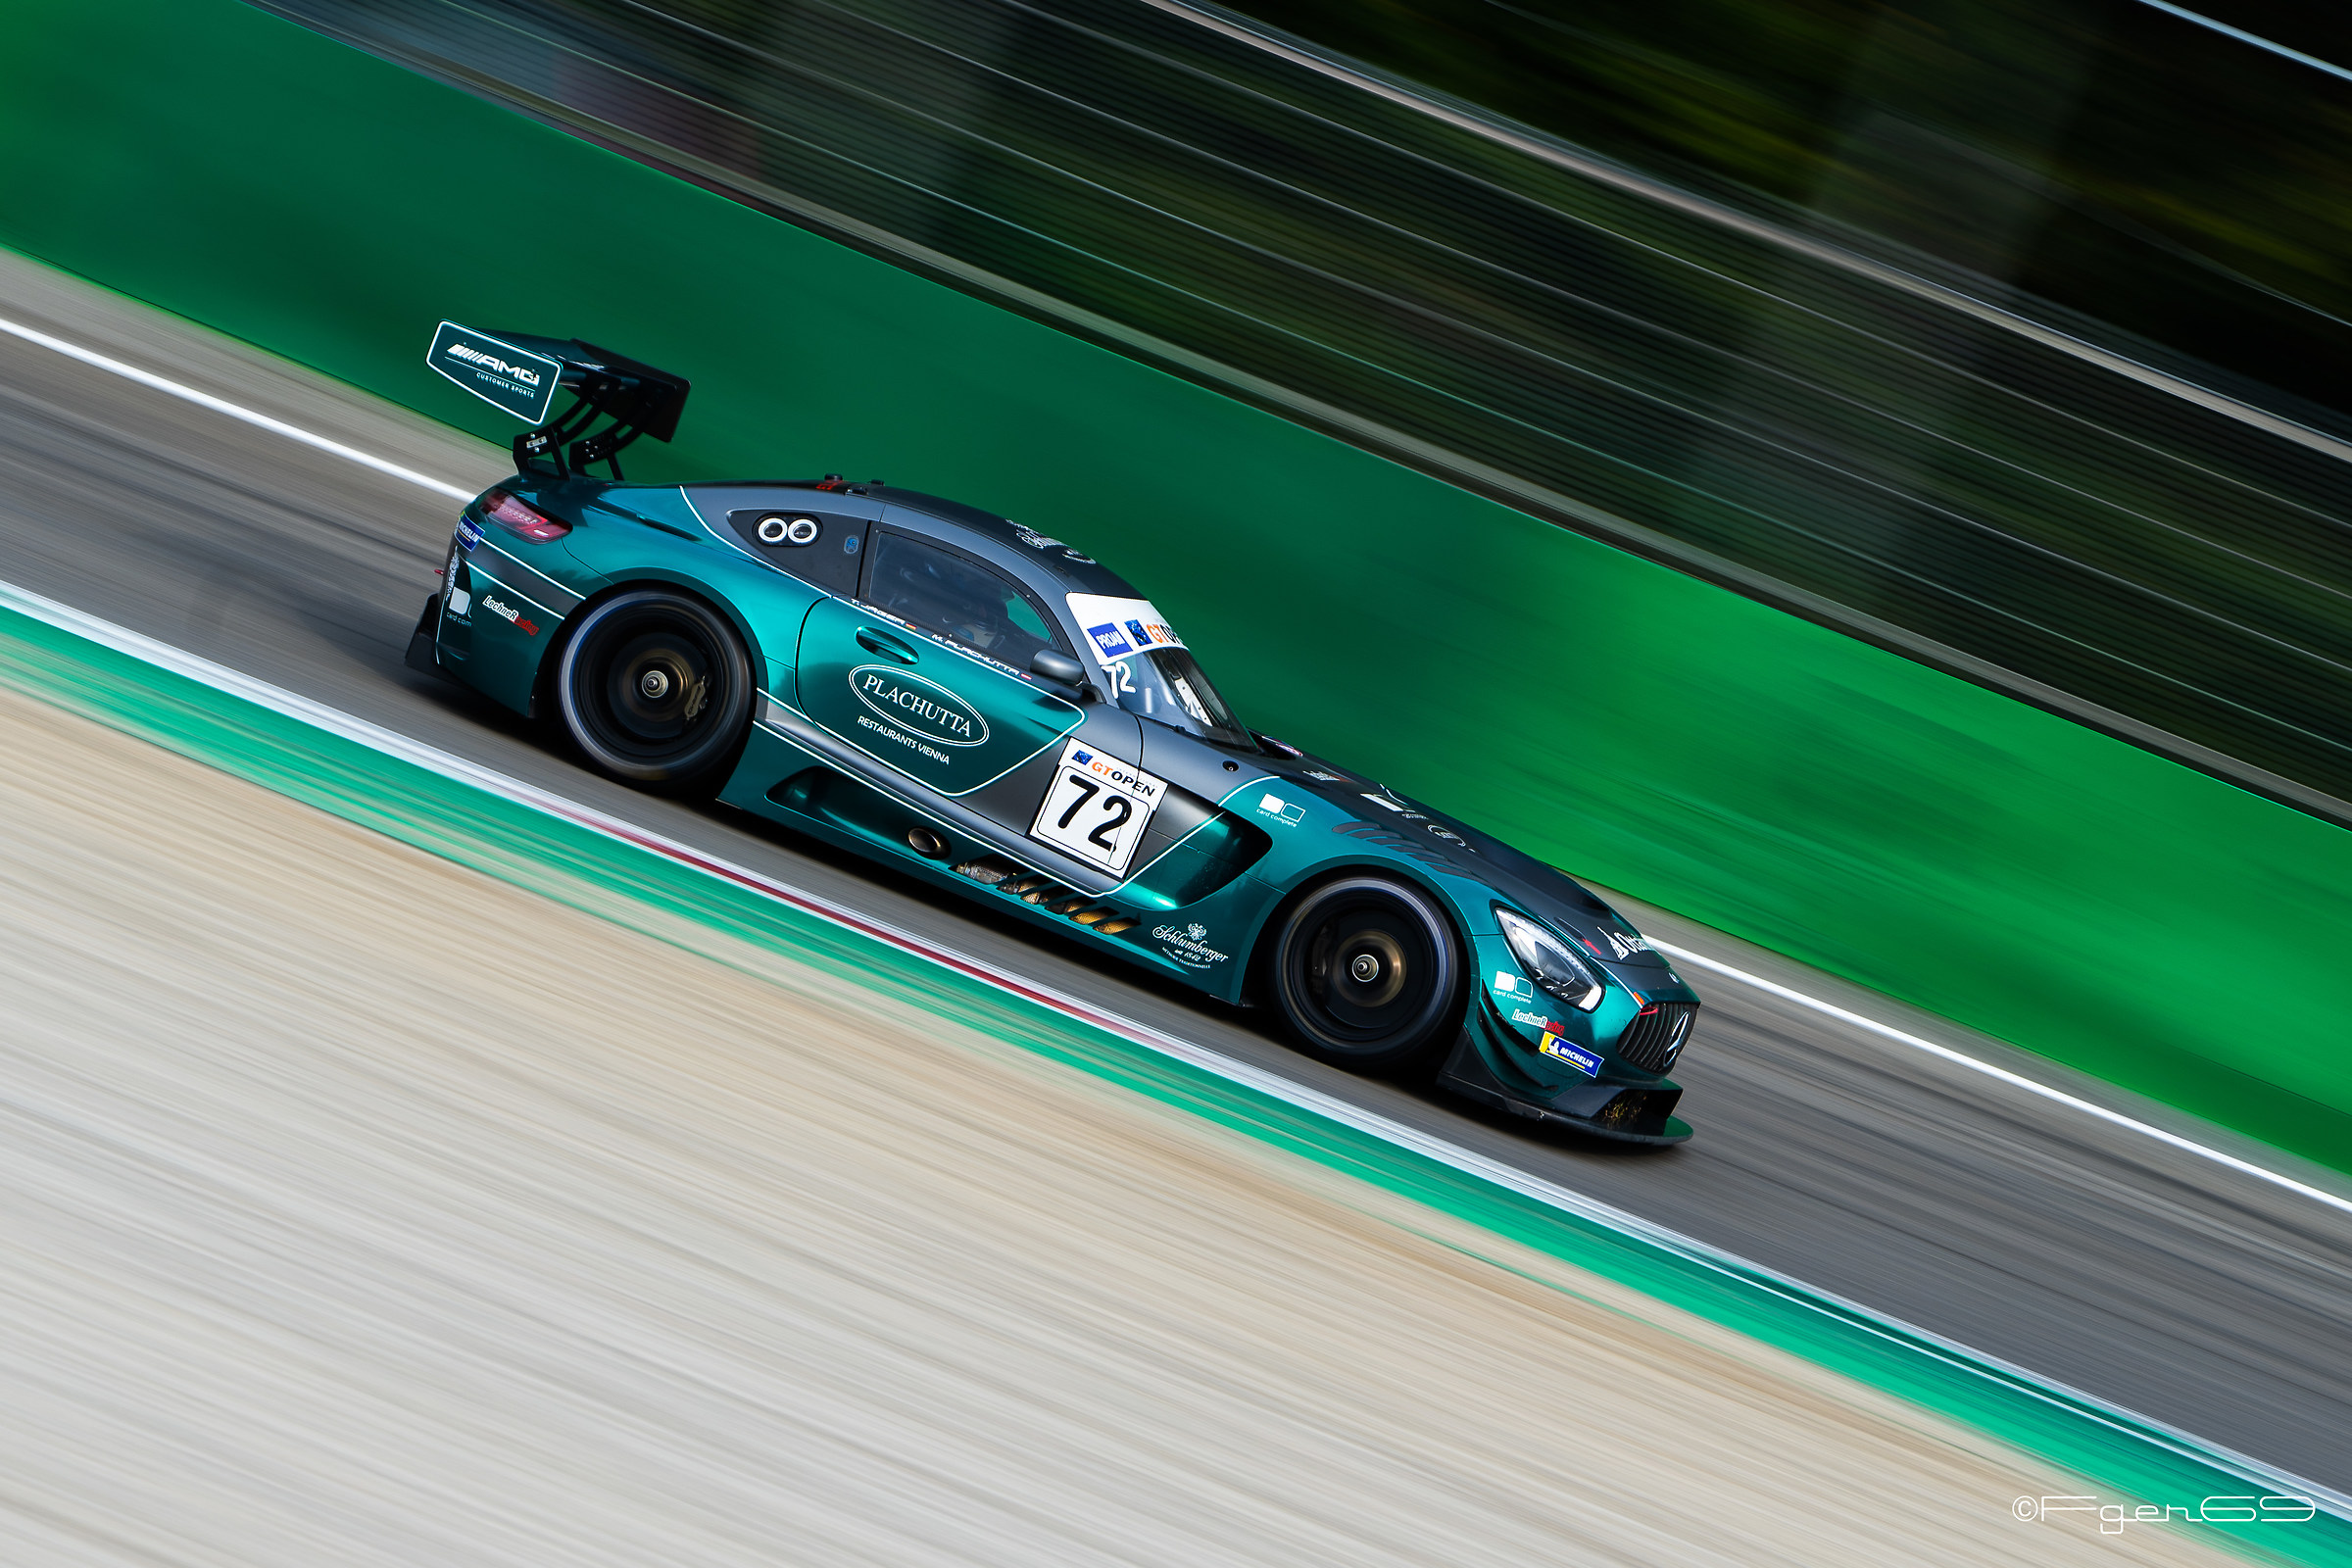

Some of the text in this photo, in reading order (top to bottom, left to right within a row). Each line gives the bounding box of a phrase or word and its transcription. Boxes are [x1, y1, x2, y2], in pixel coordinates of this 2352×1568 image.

[476, 371, 535, 399] CUSTOMER SPORTS
[1100, 661, 1137, 700] 72
[862, 673, 971, 738] PLACHUTTA
[857, 715, 950, 765] RESTAURANTS VIENNA
[1057, 774, 1133, 853] 72
[1256, 808, 1298, 828] card complete
[1152, 924, 1229, 963] Schlumberger
[1493, 988, 1532, 1004] card complete
[1559, 1047, 1594, 1068] MICHELIN
